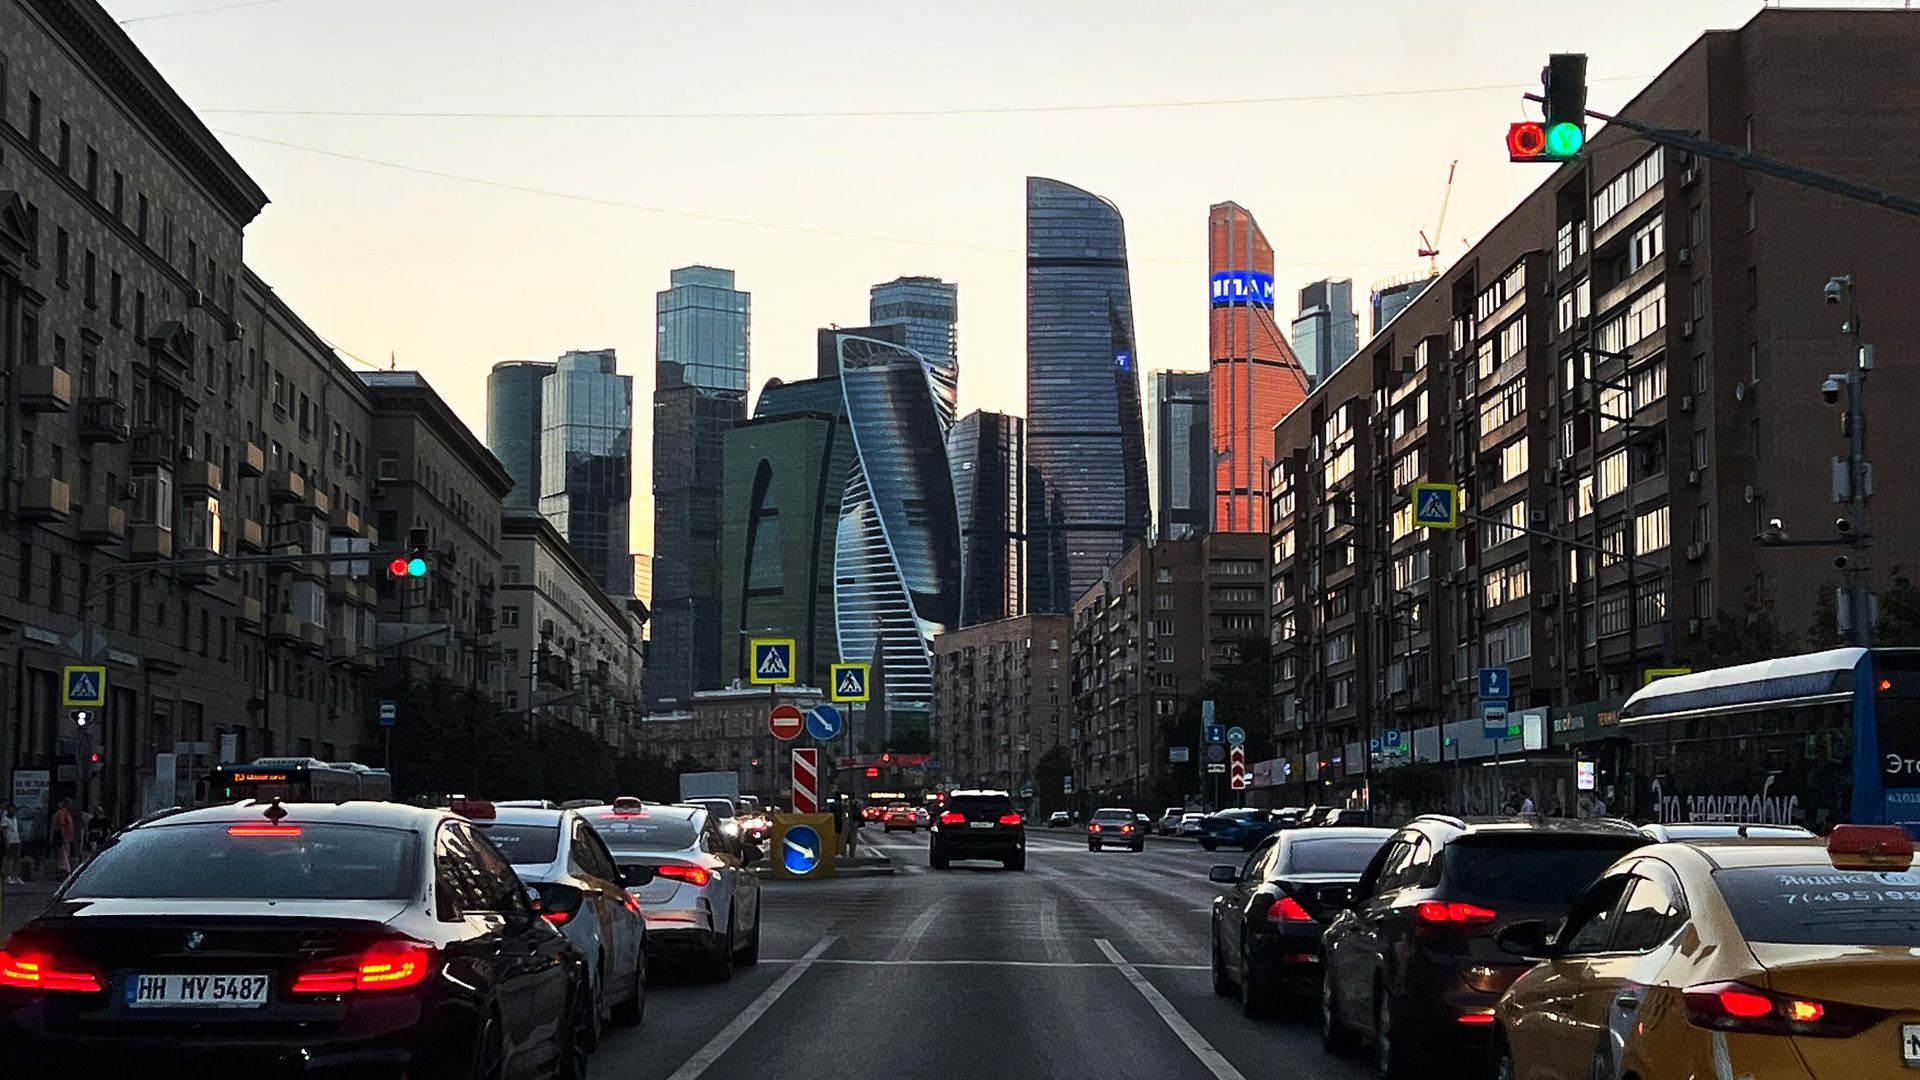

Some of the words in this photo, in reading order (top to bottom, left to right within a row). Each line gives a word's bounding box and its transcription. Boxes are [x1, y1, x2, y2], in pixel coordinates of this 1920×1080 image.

[138, 977, 166, 1000] HH
[181, 977, 208, 1000] MY
[213, 977, 266, 1000] 5487
